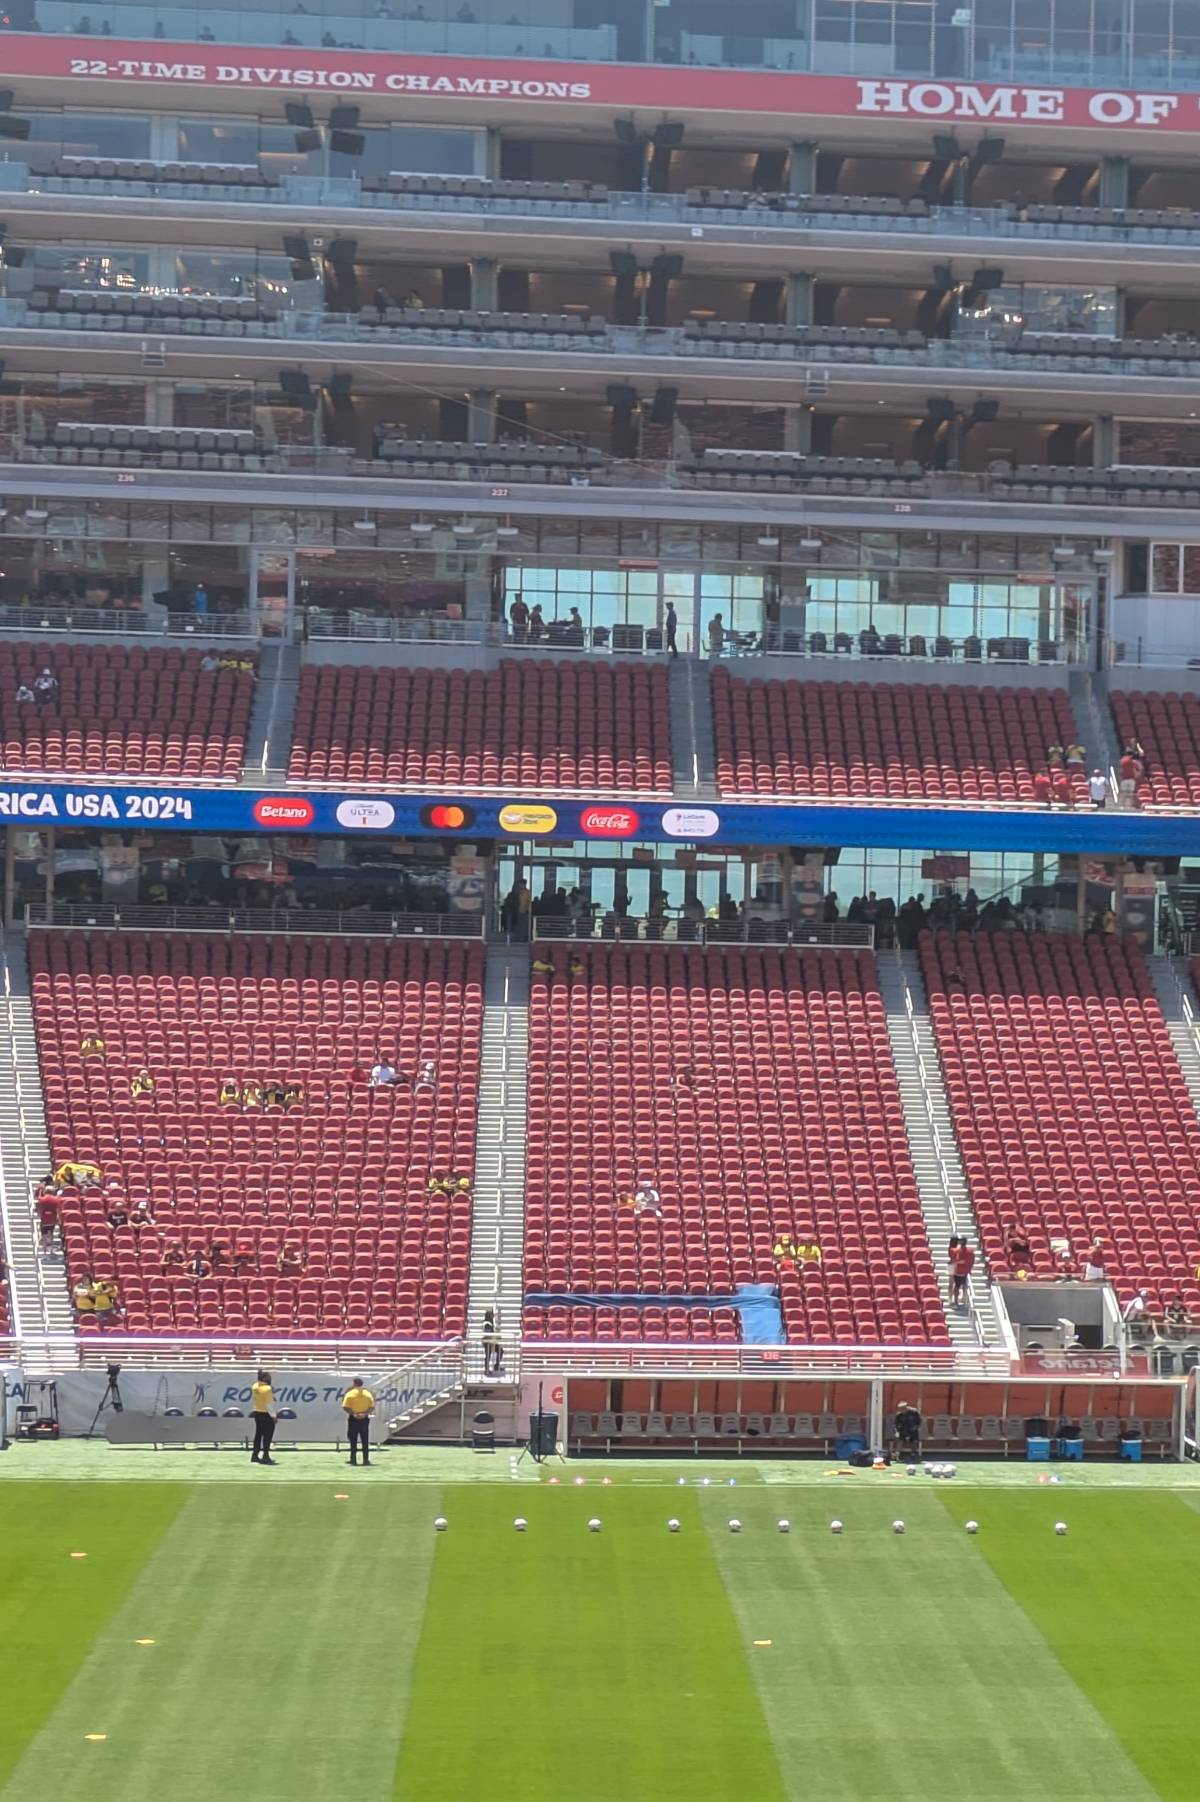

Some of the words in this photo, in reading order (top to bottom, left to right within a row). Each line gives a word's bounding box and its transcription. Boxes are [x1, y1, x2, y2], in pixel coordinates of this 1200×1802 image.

[70, 59, 206, 79] 22-TIME
[216, 66, 376, 88] DIVISION
[385, 74, 591, 99] CHAMPIONS
[856, 80, 1064, 120] HOME
[1088, 92, 1178, 125] OF
[65, 793, 120, 818] USA
[125, 795, 192, 820] 2024
[260, 805, 308, 819] Betano
